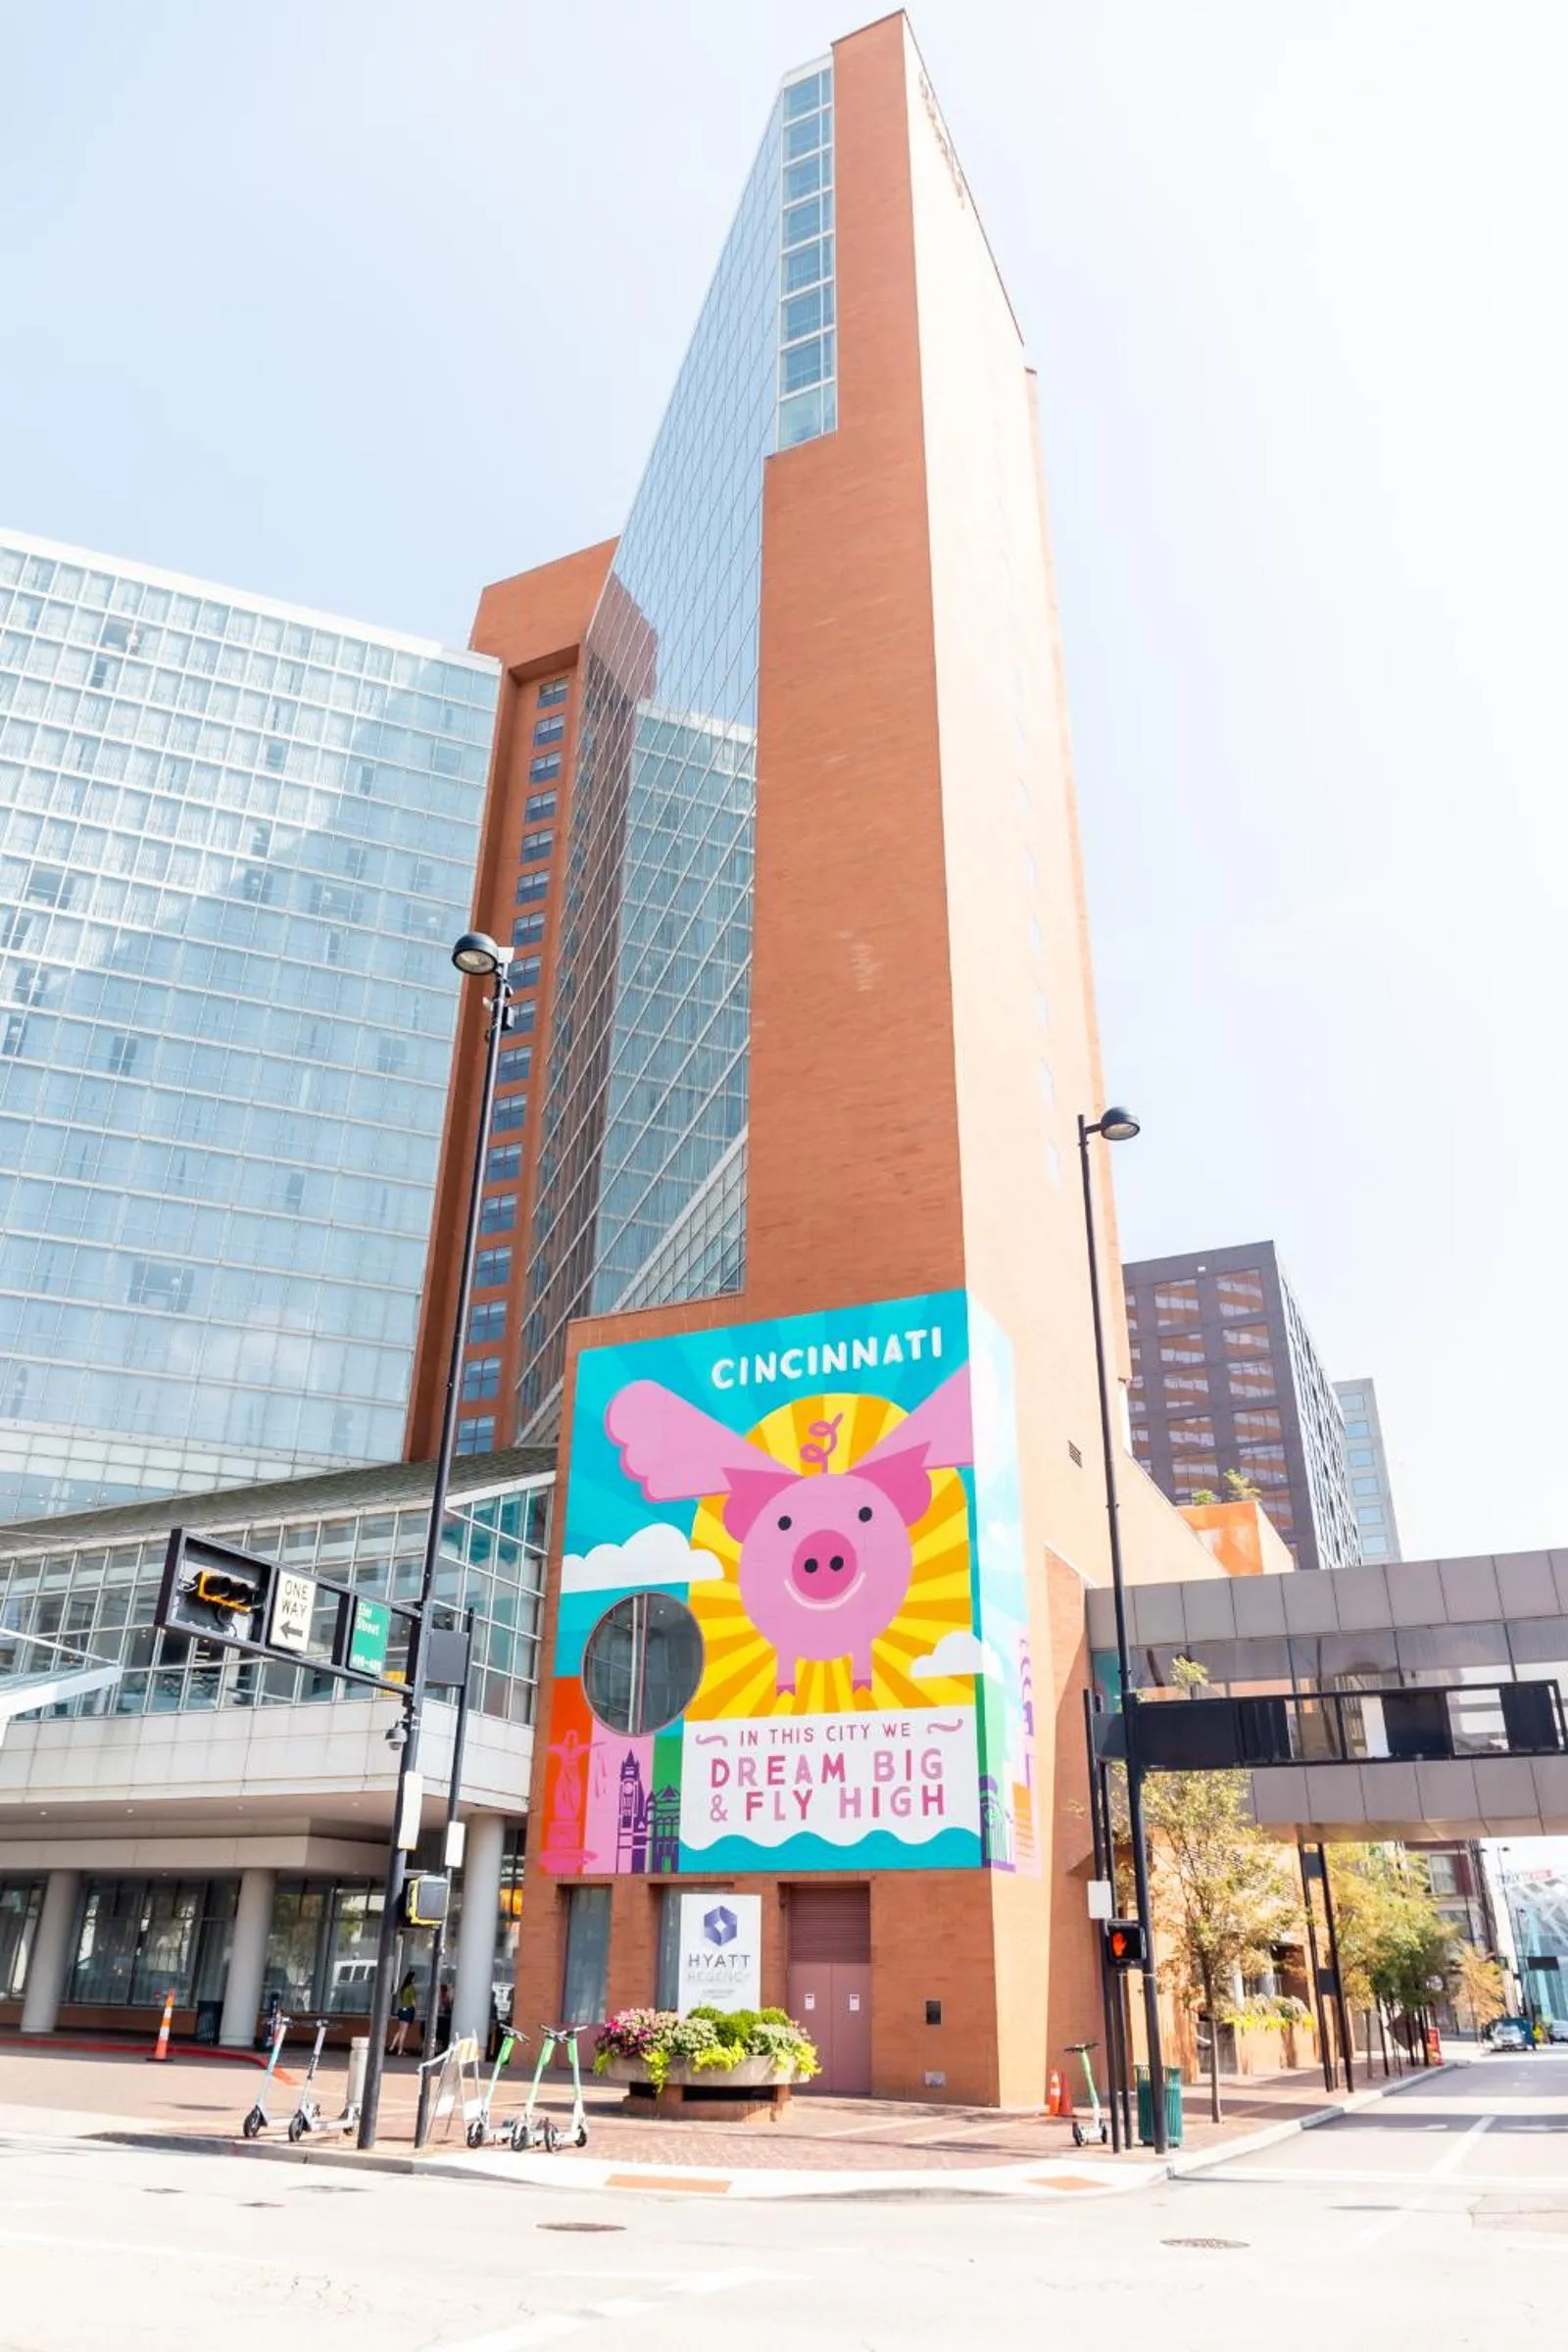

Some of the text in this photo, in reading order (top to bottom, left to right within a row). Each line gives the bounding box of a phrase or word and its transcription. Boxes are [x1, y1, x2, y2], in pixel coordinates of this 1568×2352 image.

[711, 1327, 942, 1389] CINCINNATI
[284, 1580, 309, 1600] ONE
[281, 1598, 307, 1620] WAY
[740, 1723, 911, 1746] IN THIS CITY WE
[710, 1748, 944, 1788] DREAM BIG
[710, 1785, 945, 1823] & FLY HIGH
[688, 1954, 751, 1968] HYATT
